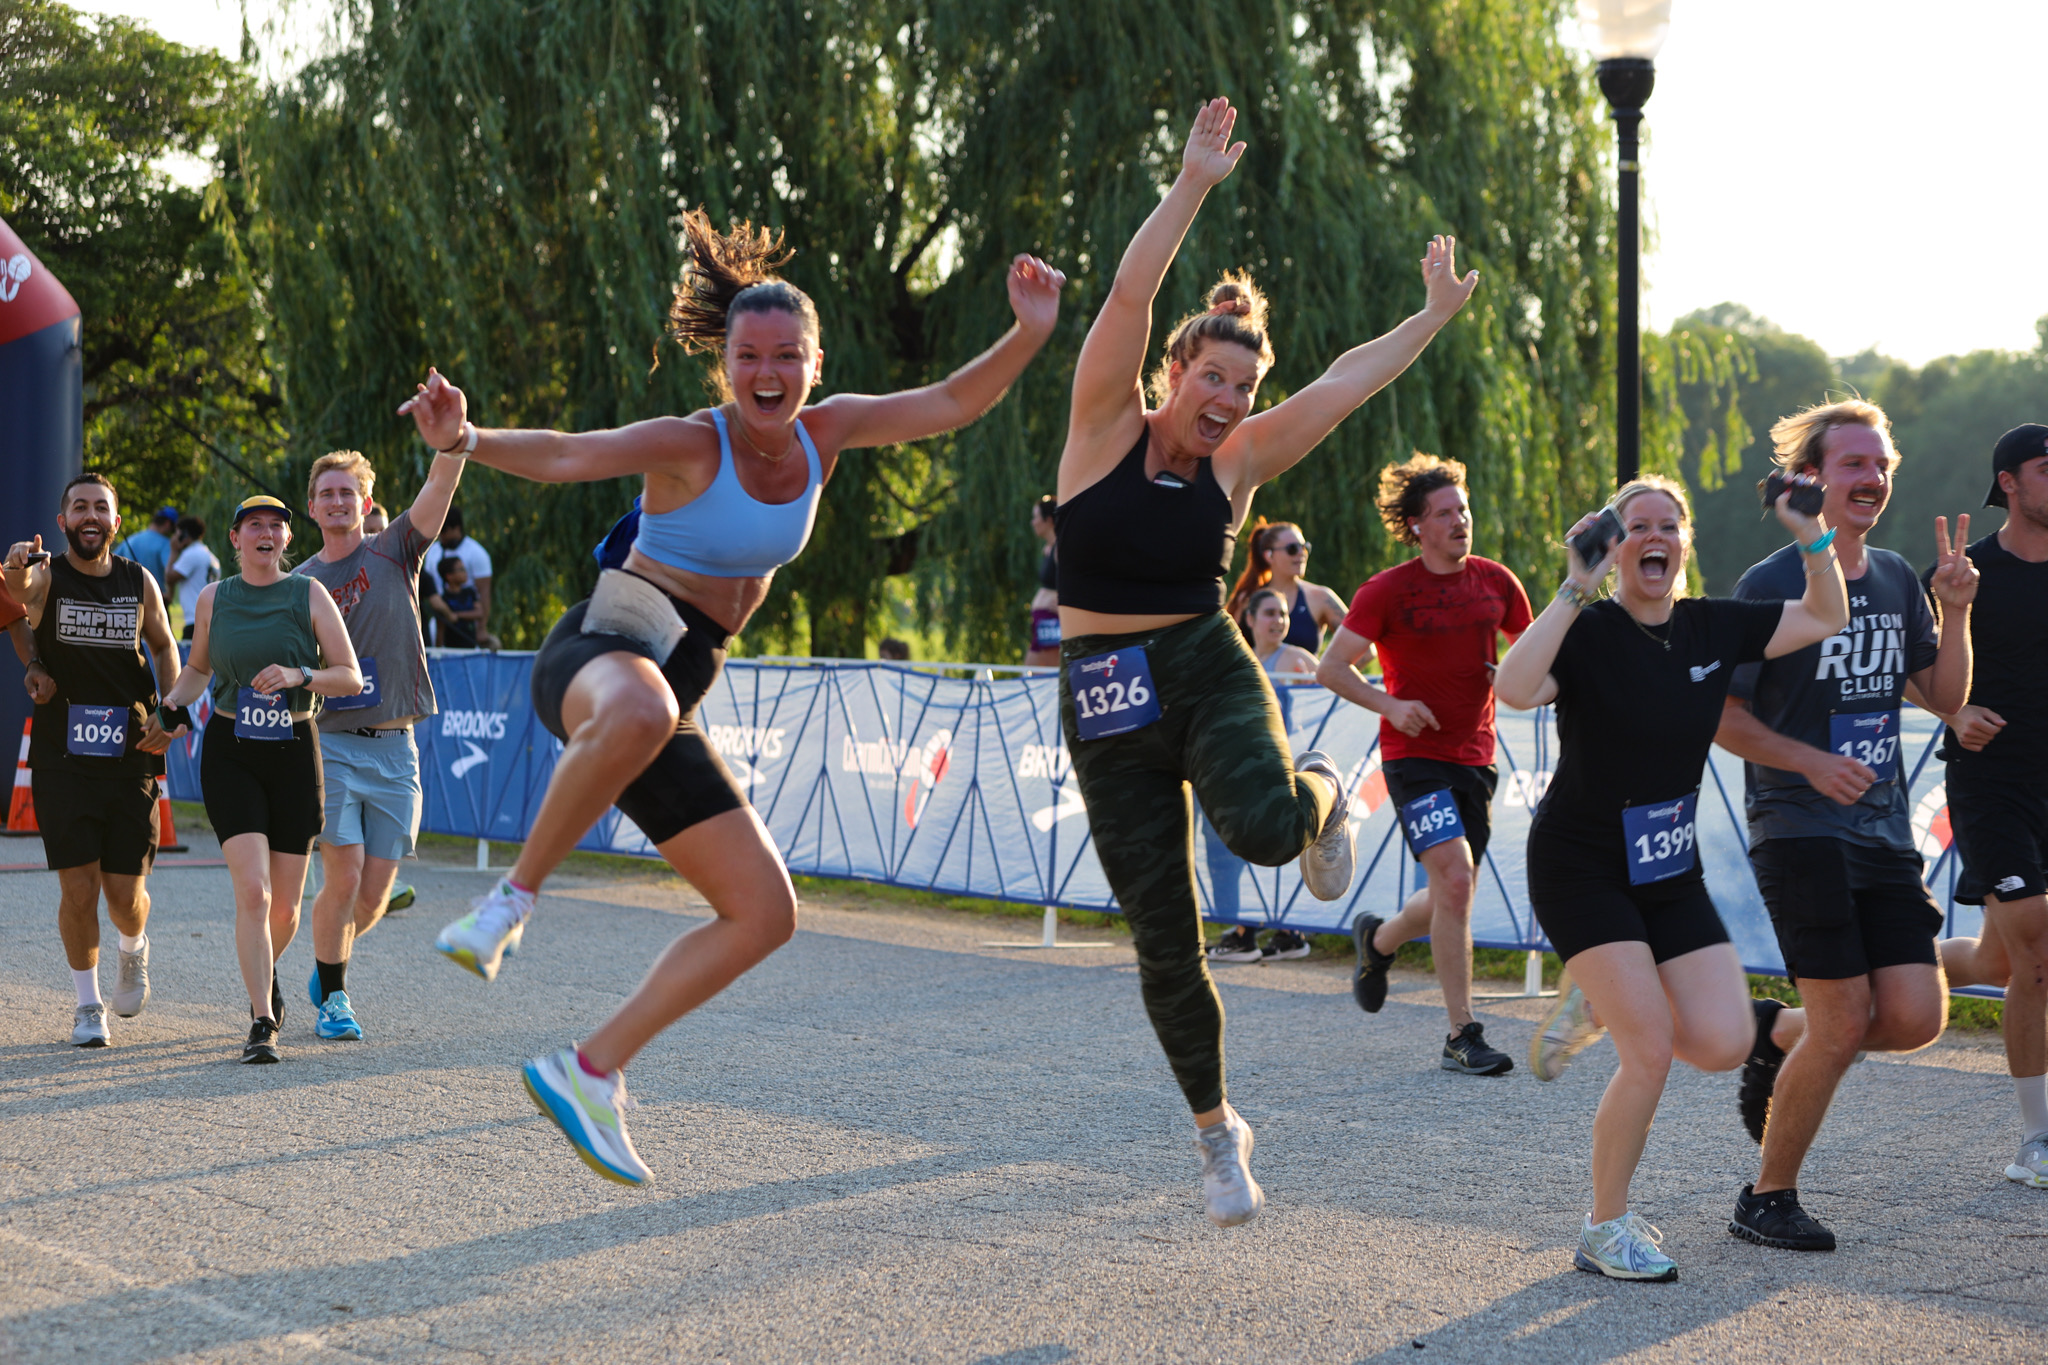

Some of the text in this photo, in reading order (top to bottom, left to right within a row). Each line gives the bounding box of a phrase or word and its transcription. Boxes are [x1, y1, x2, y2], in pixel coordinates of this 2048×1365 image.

[111, 596, 138, 604] CAPTAIN
[60, 604, 136, 628] EMPIRE
[60, 624, 136, 640] SPIKES BACK
[1815, 629, 1906, 681] RUN
[1076, 675, 1150, 719] 1326
[1841, 674, 1894, 695] CLUB
[241, 705, 293, 728] 1098
[442, 709, 509, 740] BROOKS
[73, 723, 124, 745] 1096
[1838, 735, 1899, 767] 1367
[1409, 806, 1457, 840] 1495
[1635, 821, 1695, 864] 1399
